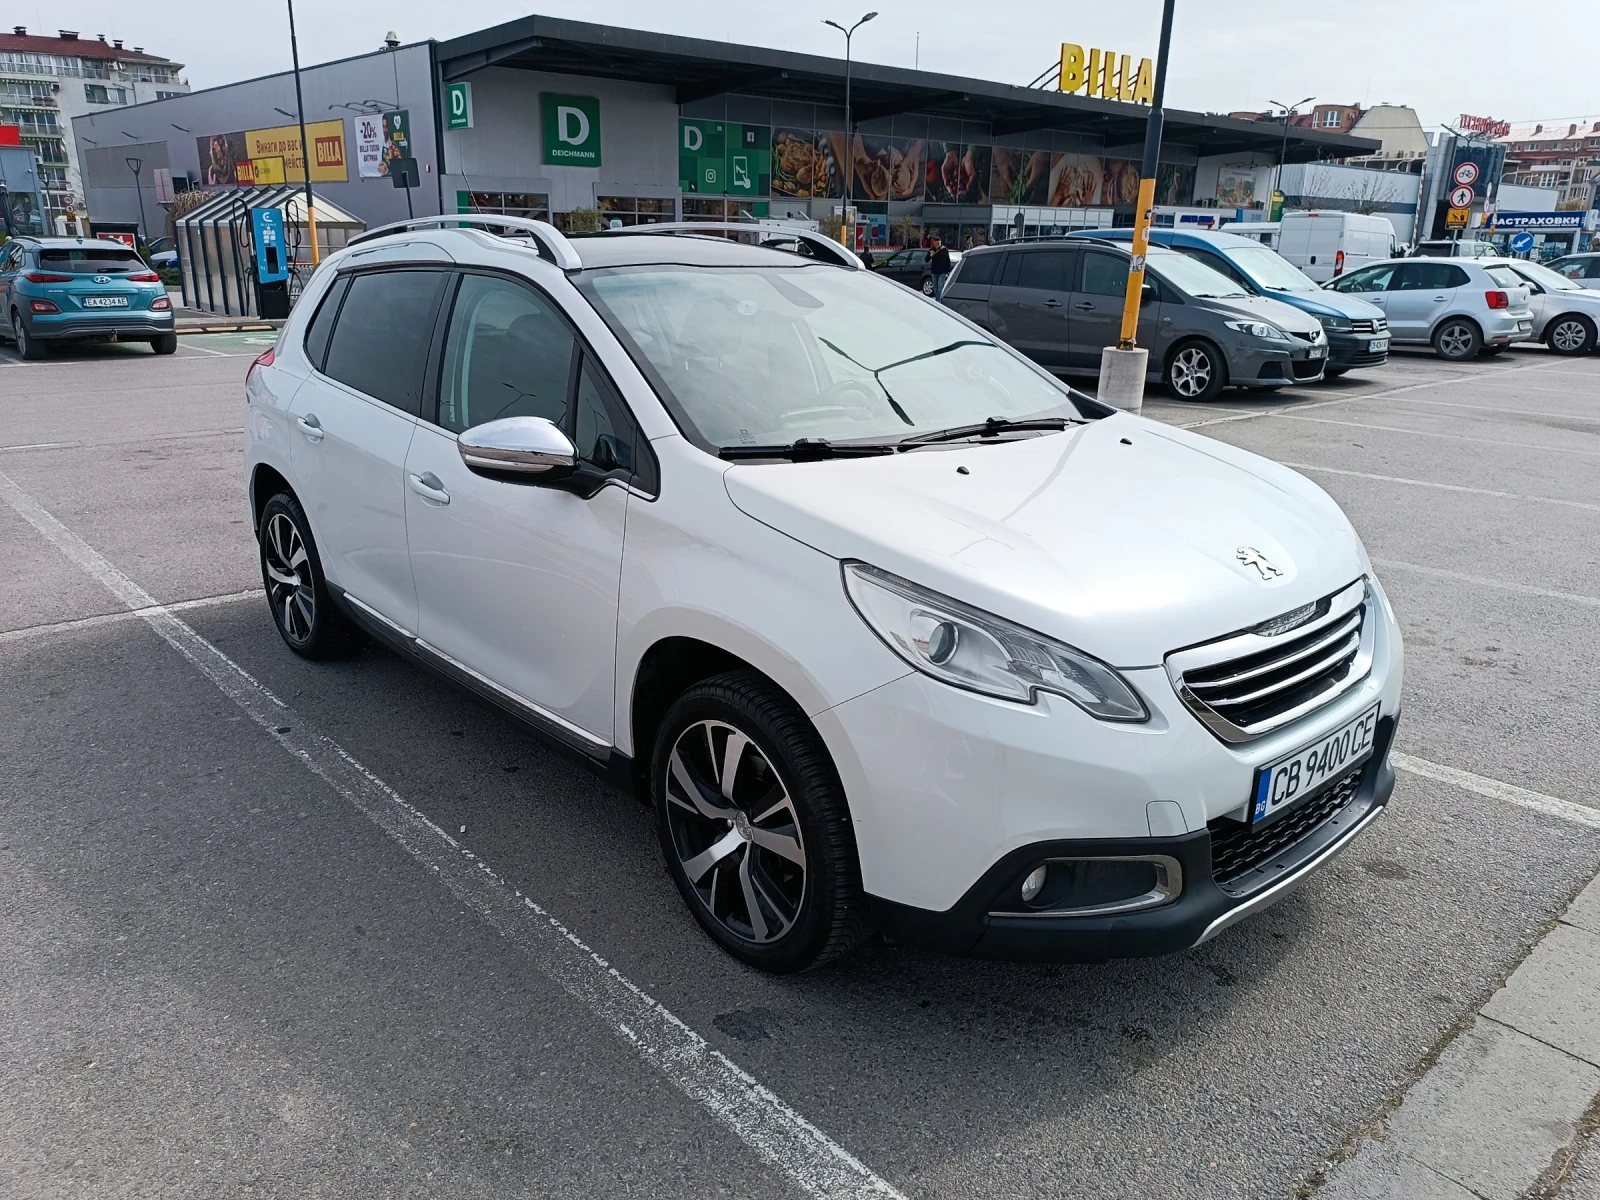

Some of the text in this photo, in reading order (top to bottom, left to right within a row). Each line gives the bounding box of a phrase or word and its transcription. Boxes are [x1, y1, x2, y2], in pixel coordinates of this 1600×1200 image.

[1059, 43, 1153, 104] BILLA
[452, 90, 464, 116] D
[360, 121, 377, 139] -20%
[557, 106, 590, 146] D
[256, 139, 278, 154] Винаги
[278, 141, 287, 155] до
[287, 139, 298, 151] вас
[684, 125, 703, 151] D
[317, 141, 342, 163] BILLA
[552, 149, 595, 159] DEICHMANN
[237, 164, 254, 181] BILLA
[87, 297, 127, 307] EA 4234 AE
[1271, 712, 1375, 806] CB 9400 CE
[1255, 800, 1266, 815] BG
